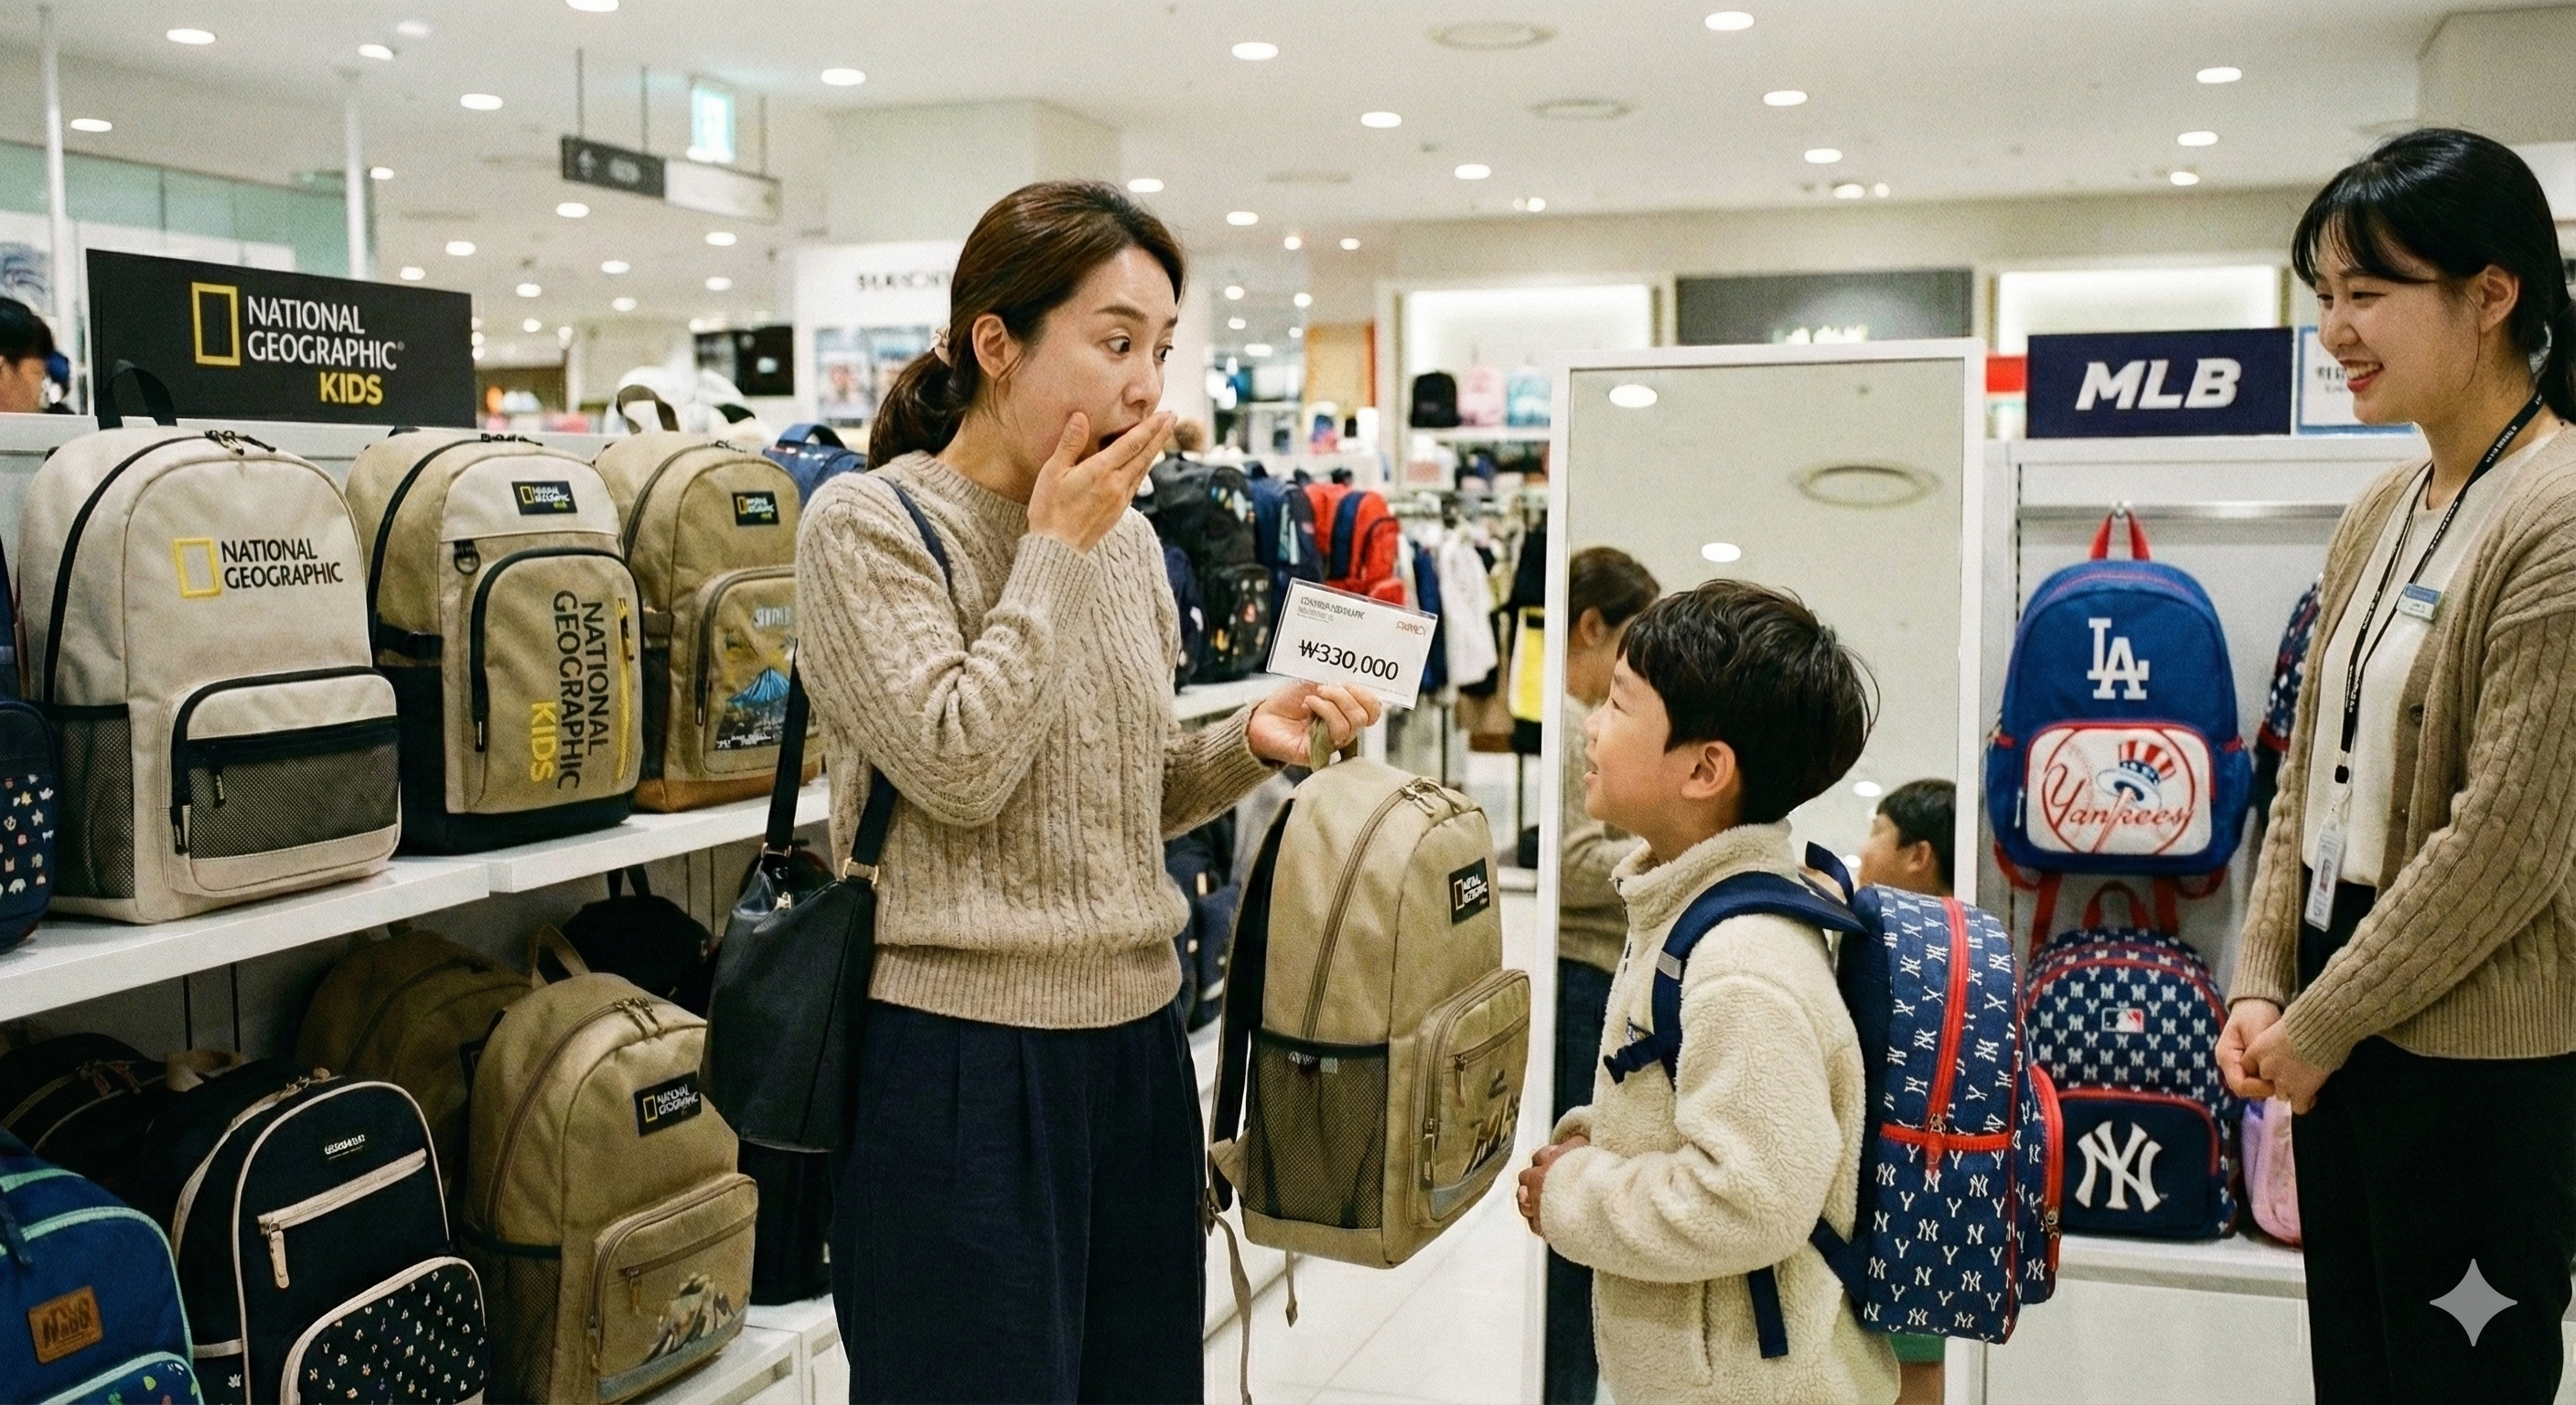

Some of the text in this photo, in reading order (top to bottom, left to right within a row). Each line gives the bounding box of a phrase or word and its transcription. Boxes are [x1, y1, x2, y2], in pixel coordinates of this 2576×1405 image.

[247, 295, 366, 335] NATIONAL
[247, 330, 398, 370] GEOGRAPHIC
[319, 371, 383, 405] KIDS
[2075, 358, 2242, 411] MLB
[220, 538, 318, 563] NATIONAL
[224, 562, 344, 589] GEOGRAPHIC
[581, 601, 610, 756] NATIONAL
[1298, 638, 1400, 681] ₩330,000
[2087, 617, 2150, 701] LA
[553, 590, 585, 790] GEOGRAPHIC
[531, 702, 557, 782] KIDS
[2075, 1121, 2163, 1213] NY
